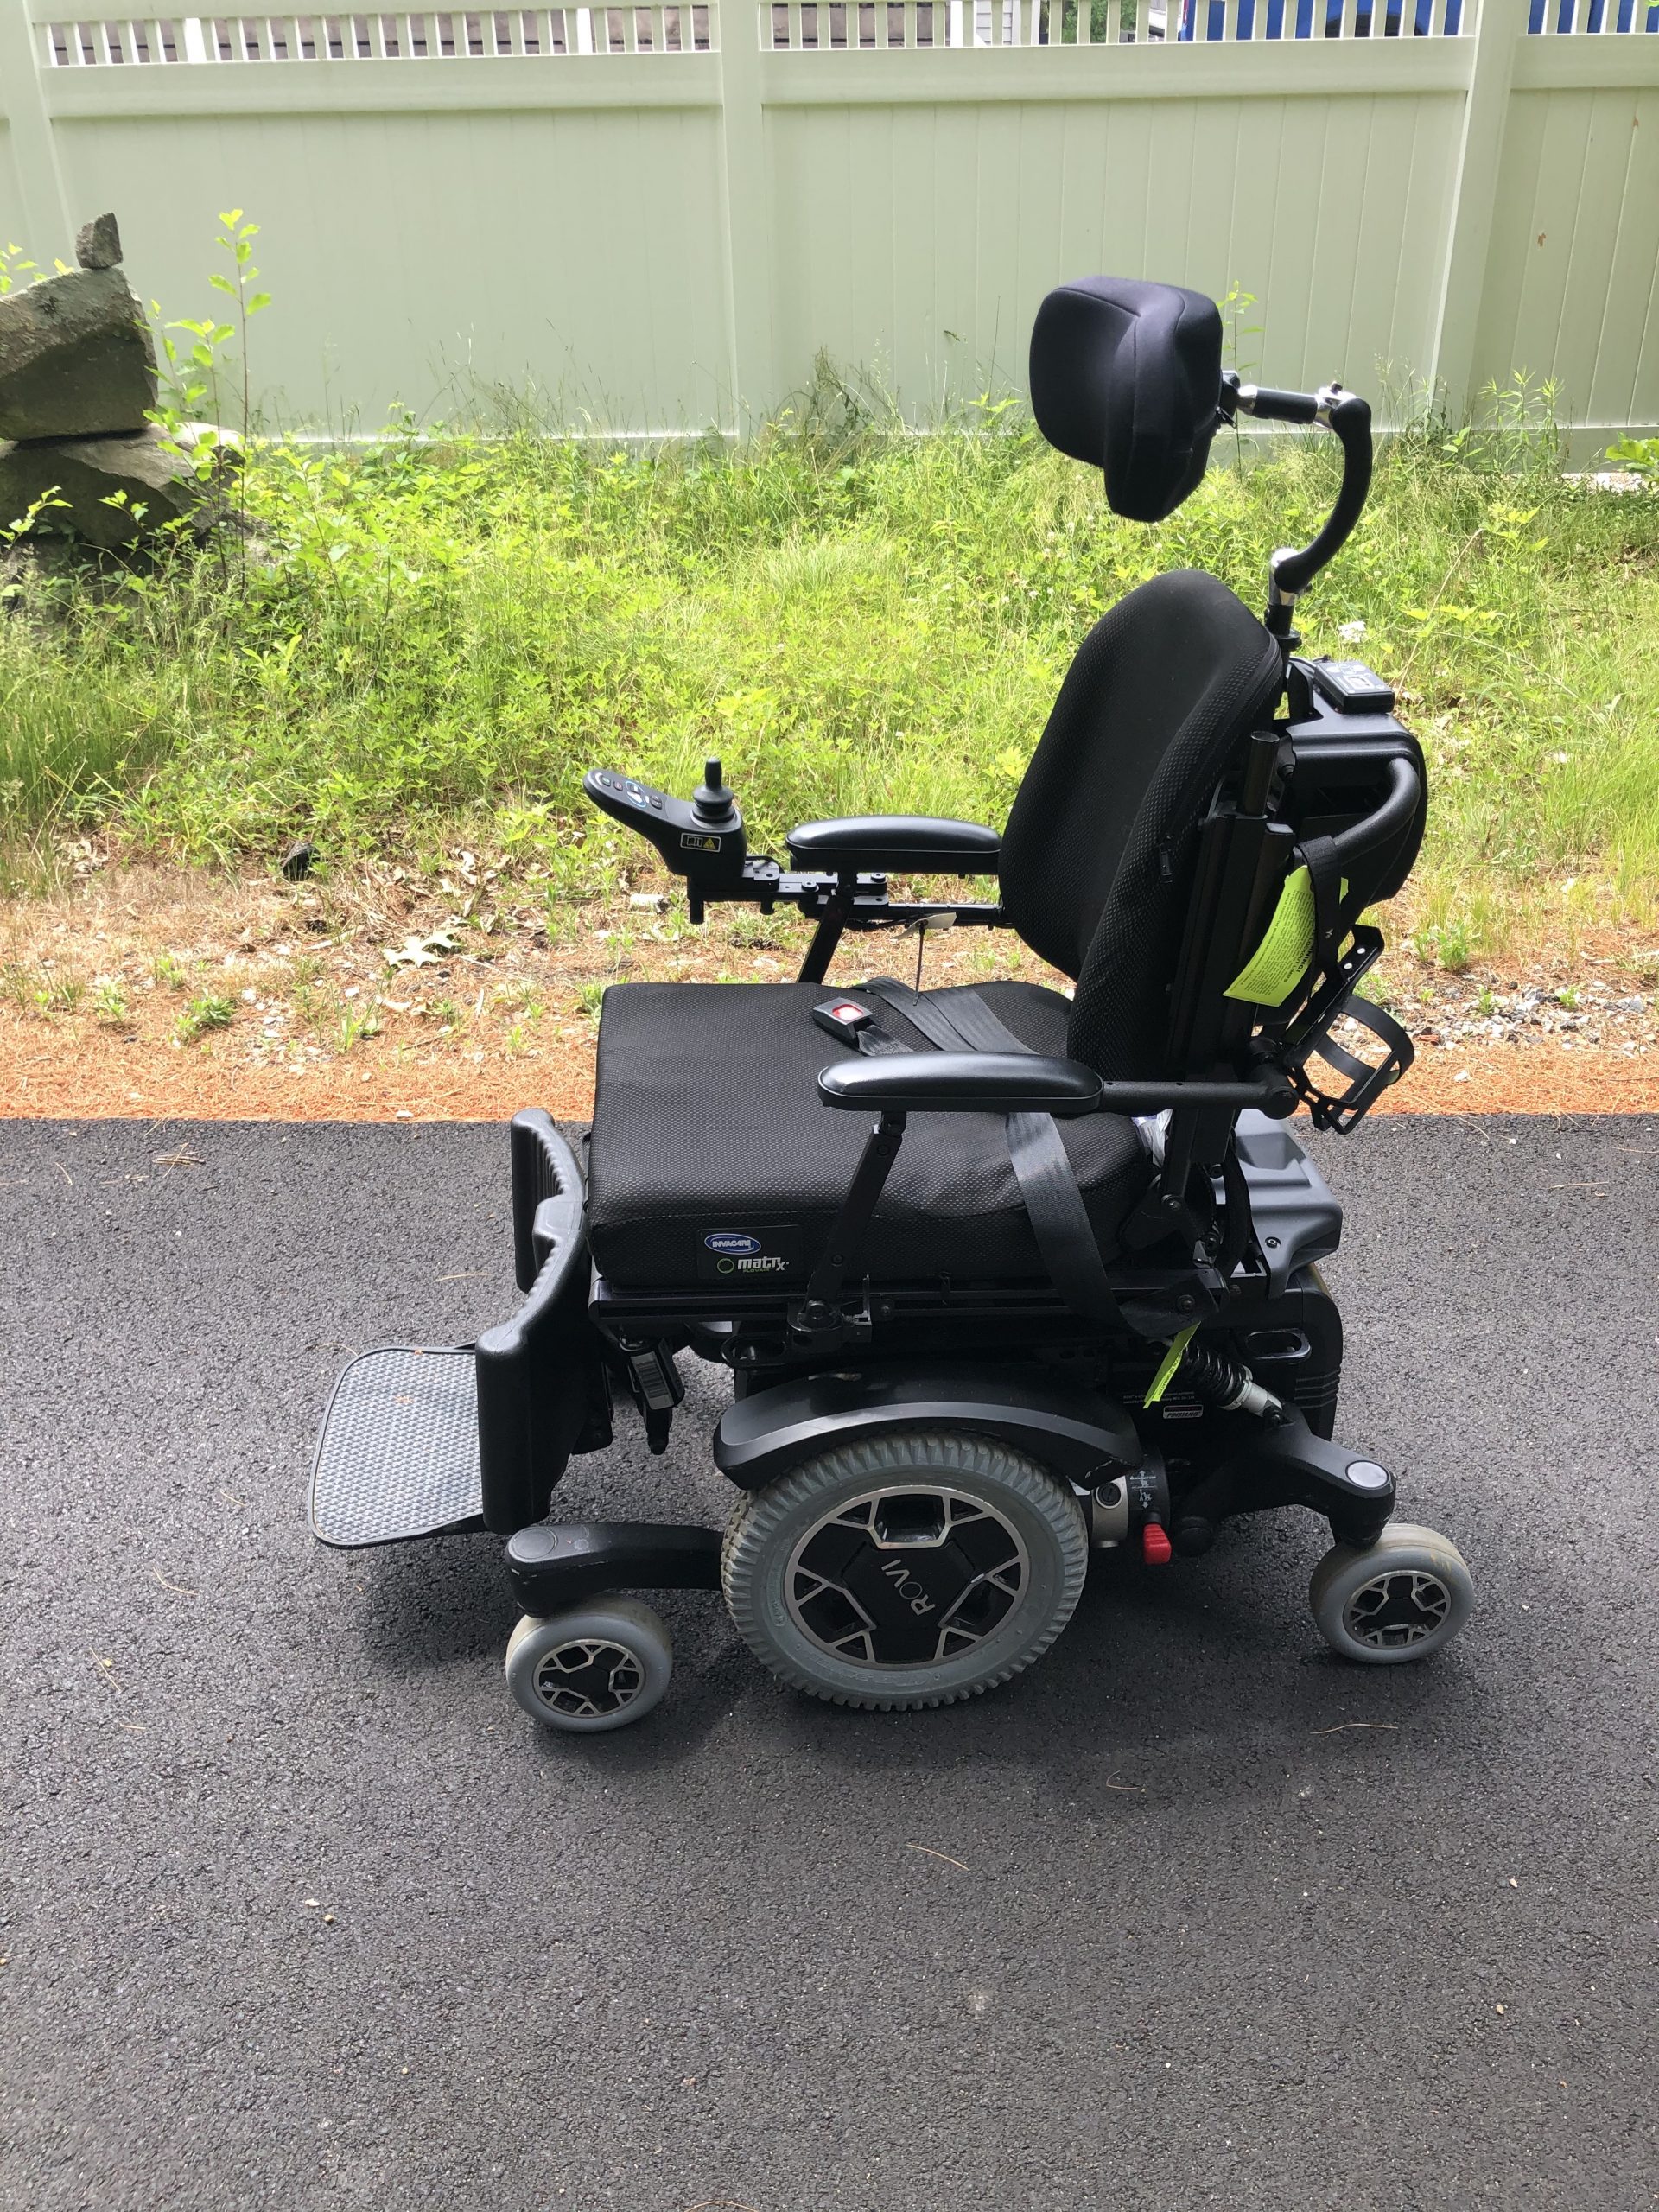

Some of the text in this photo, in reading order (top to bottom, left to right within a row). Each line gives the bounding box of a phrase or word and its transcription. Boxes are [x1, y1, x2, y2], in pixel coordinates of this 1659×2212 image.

[1283, 965, 1296, 982] LIMITS
[712, 1239, 751, 1249] INVACARE
[881, 1559, 936, 1616] ROVI
